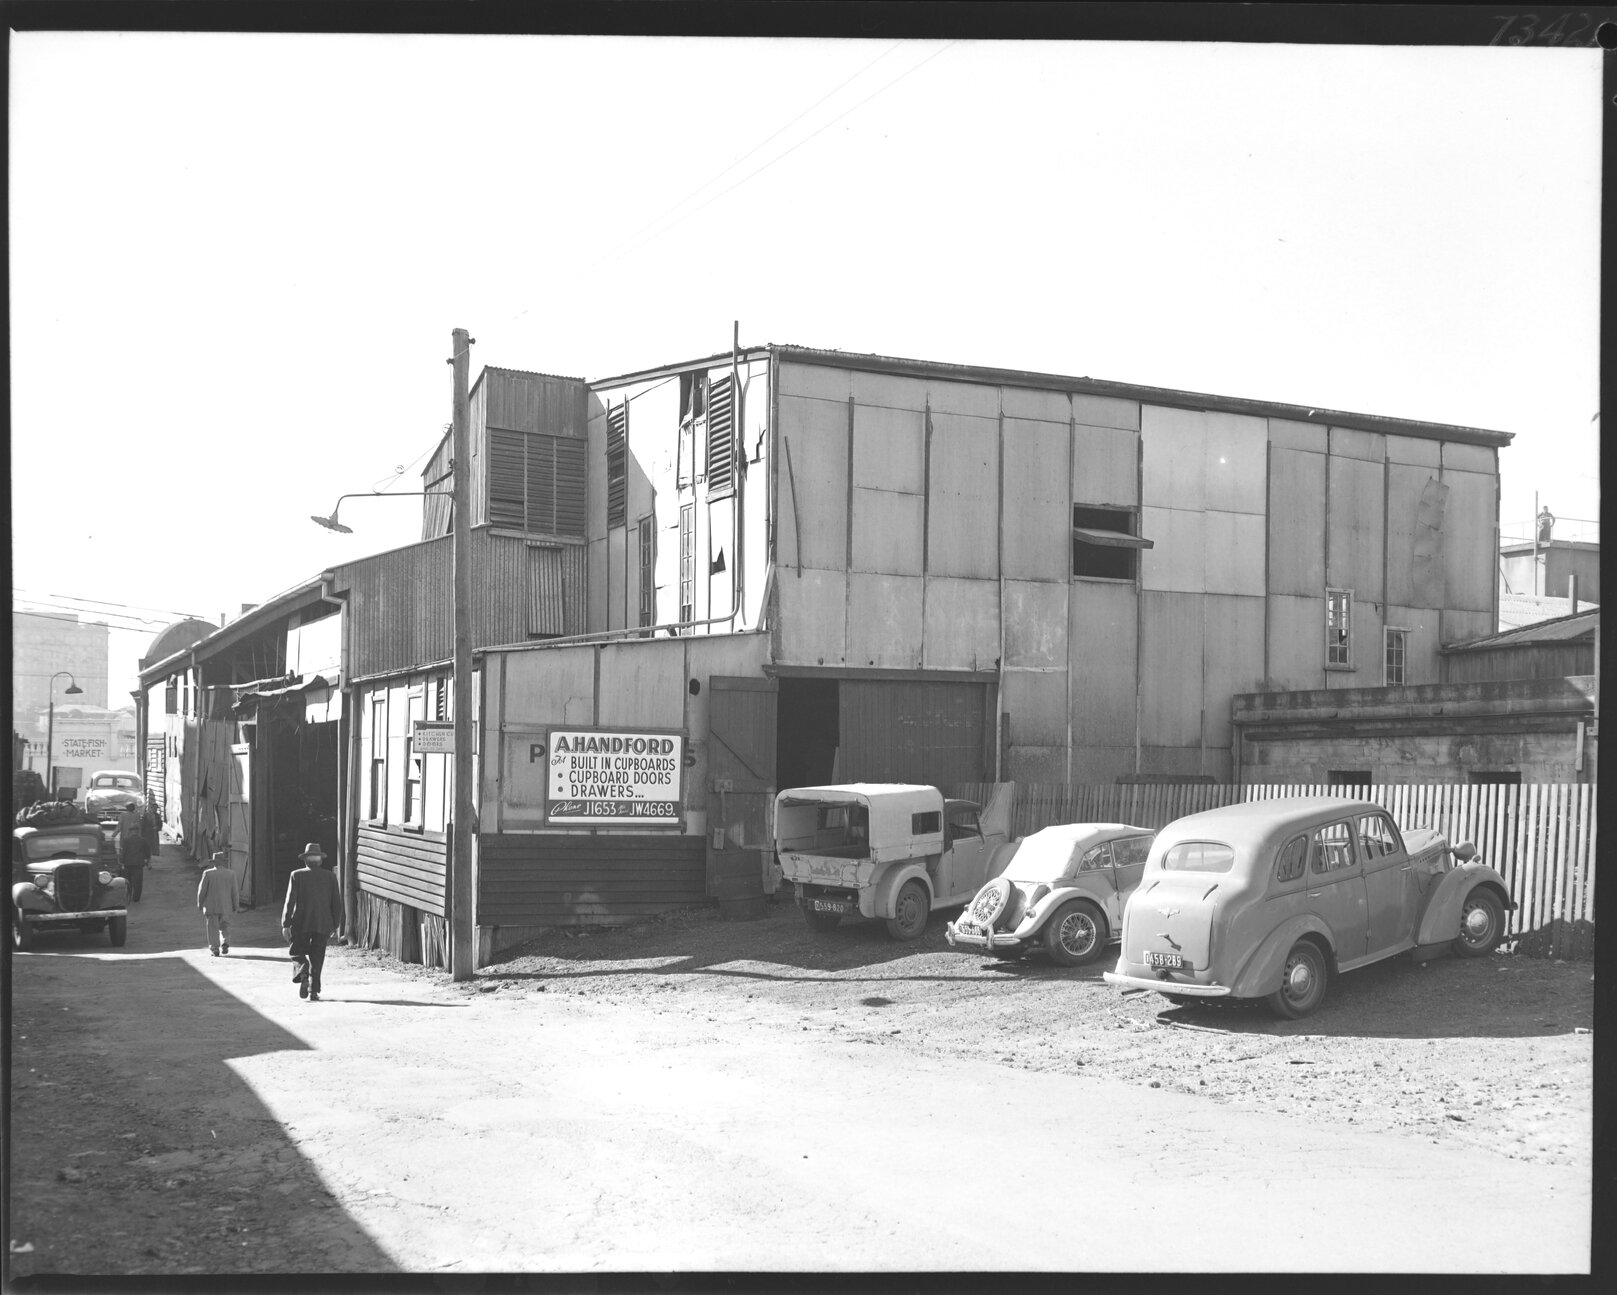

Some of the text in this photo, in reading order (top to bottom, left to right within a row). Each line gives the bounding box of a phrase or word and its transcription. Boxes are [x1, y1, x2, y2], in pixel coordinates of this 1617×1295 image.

[66, 749, 101, 758] MARKET
[570, 756, 598, 770] BUILT
[600, 756, 611, 770] IN
[614, 757, 676, 771] CUPBOARDS
[568, 771, 672, 785] CUPBOARD DOORS
[550, 801, 582, 816] Phone
